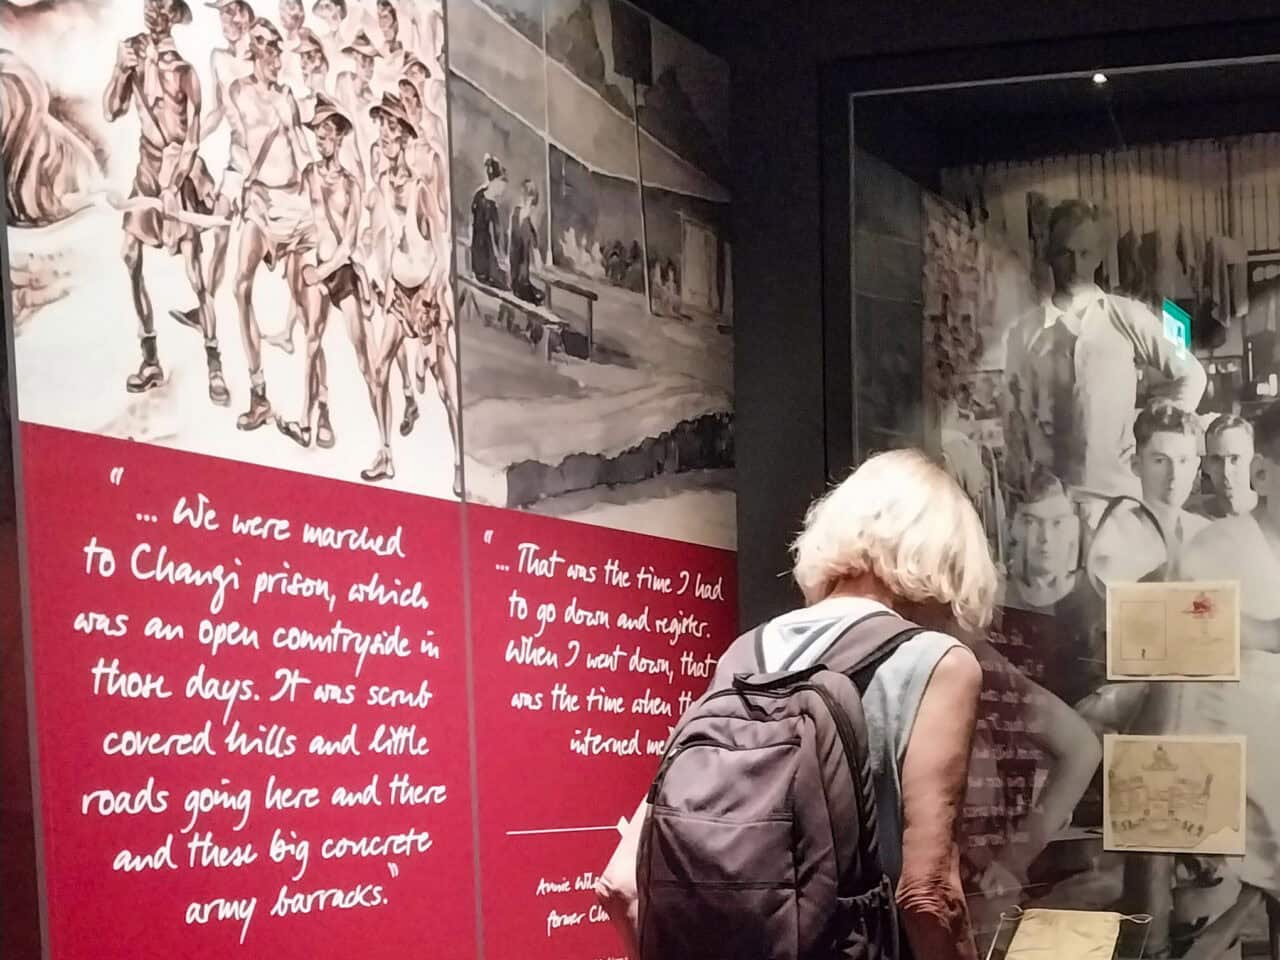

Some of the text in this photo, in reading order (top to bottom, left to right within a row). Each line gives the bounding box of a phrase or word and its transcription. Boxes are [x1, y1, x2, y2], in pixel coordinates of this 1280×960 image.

[173, 493, 219, 530] We
[232, 514, 291, 540] were
[303, 523, 406, 558] marched
[83, 537, 429, 614] to Changi prison, which
[518, 543, 566, 577] That
[567, 564, 597, 583] was
[604, 559, 631, 587] the
[637, 566, 672, 593] time
[677, 571, 689, 594] I
[695, 573, 724, 600] had
[508, 589, 710, 645] to go down and register.
[73, 612, 439, 677] was an open countryside in
[505, 636, 721, 684] When I went down, that
[91, 657, 433, 726] those days. It was scrub
[511, 692, 543, 710] was
[551, 683, 580, 712] the
[586, 686, 625, 714] time
[632, 688, 671, 716] when
[103, 720, 429, 758] covered hills and little
[570, 728, 642, 756] interned
[82, 773, 447, 833] roads going here and there
[113, 828, 432, 881] and these big concrete
[185, 897, 257, 944] army
[547, 910, 586, 936] former
